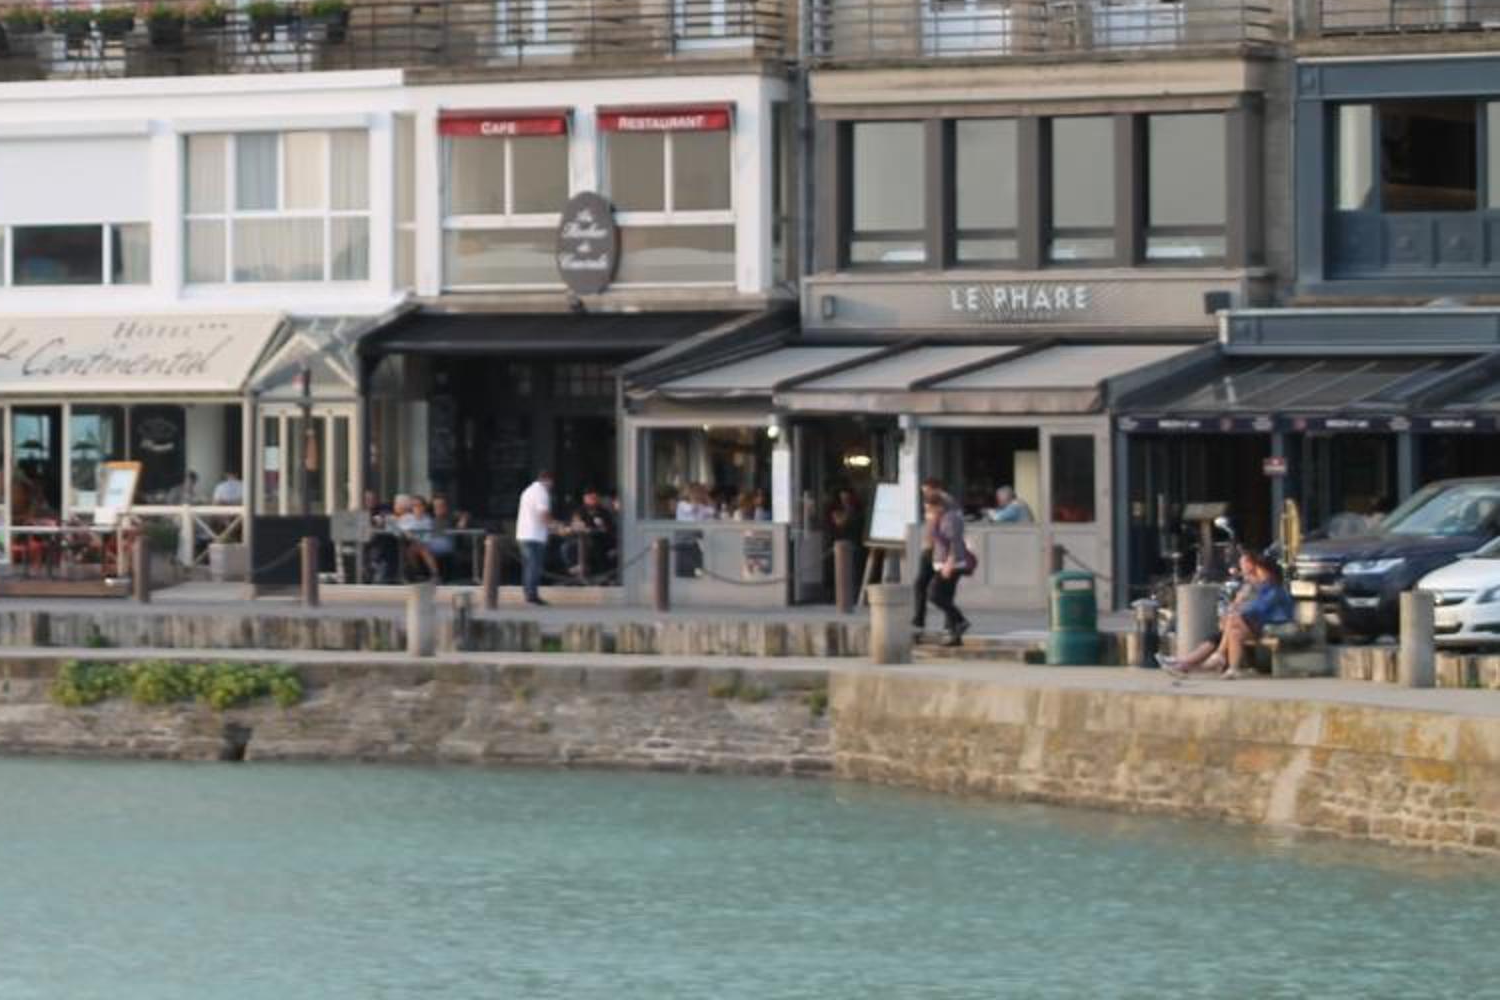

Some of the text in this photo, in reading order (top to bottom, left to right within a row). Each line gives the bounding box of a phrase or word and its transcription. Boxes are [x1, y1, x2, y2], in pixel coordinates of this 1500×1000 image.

[617, 114, 706, 131] RESTAURANT
[950, 285, 1088, 311] LE PHARE
[21, 335, 235, 377] Continental
